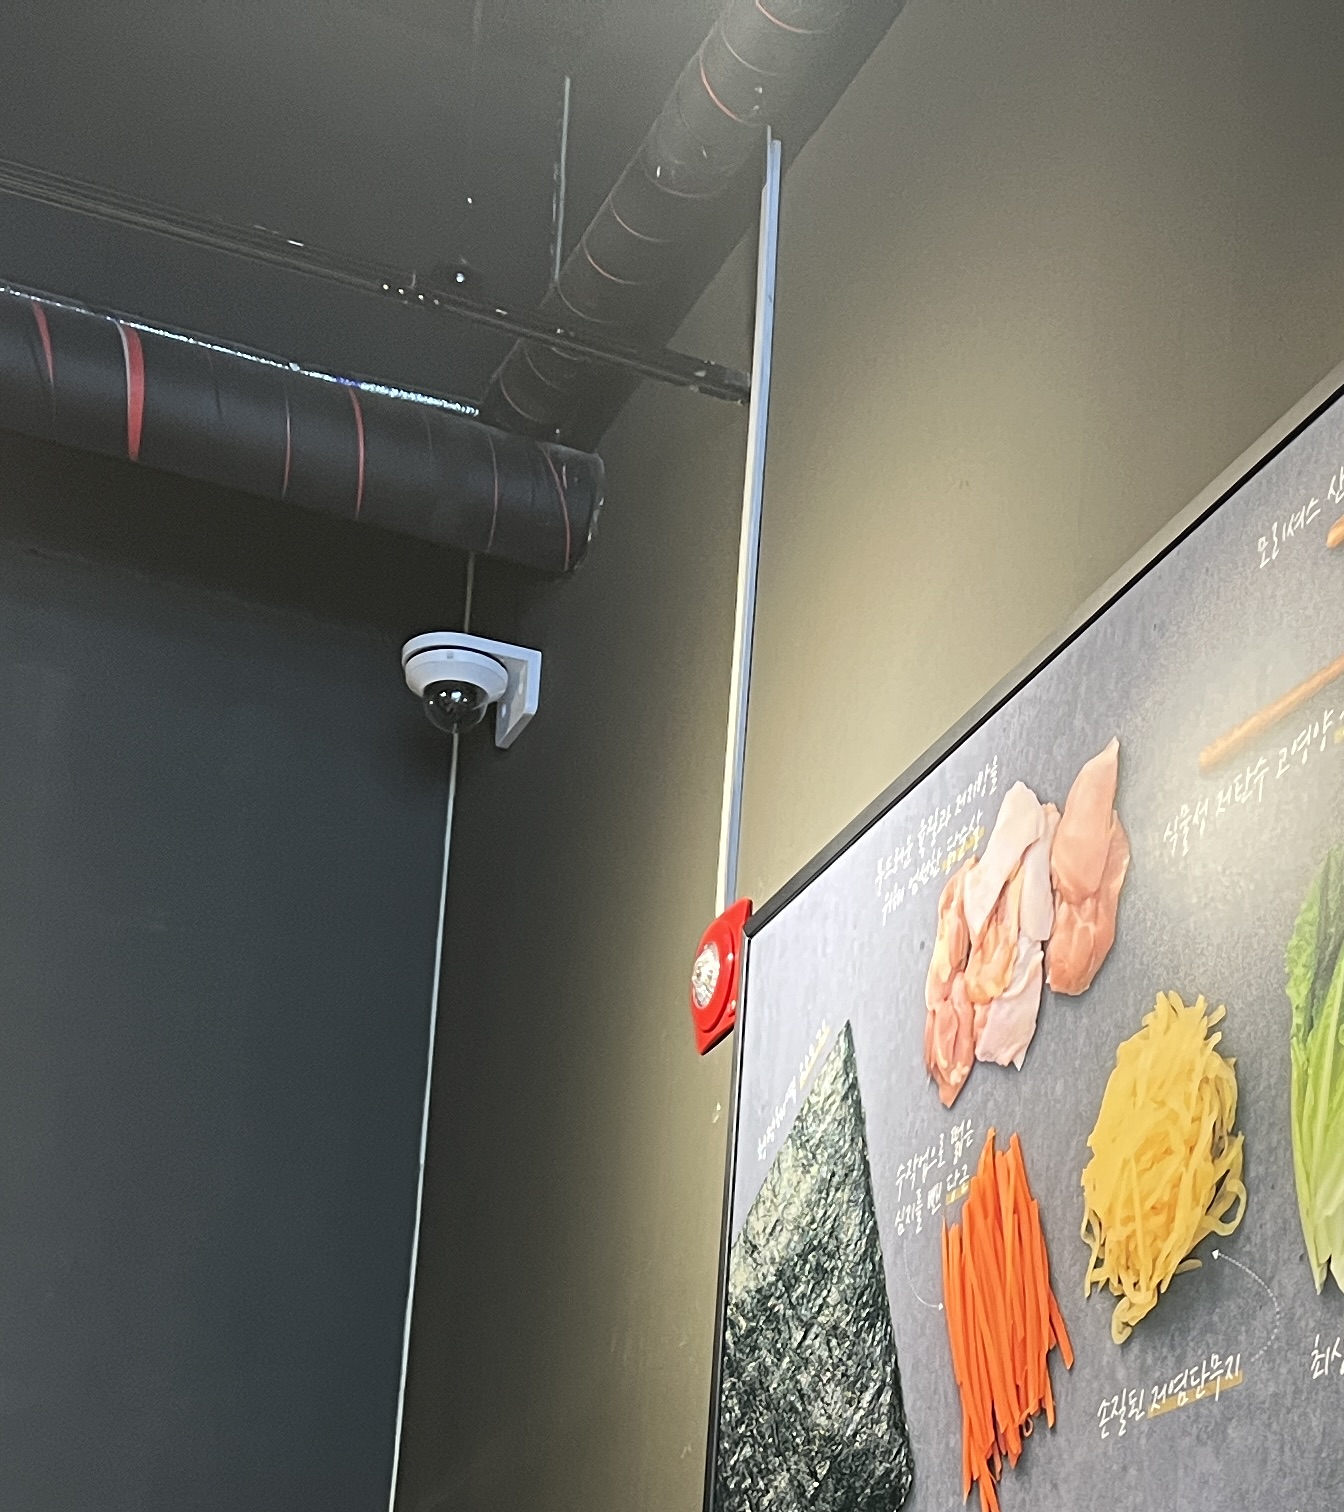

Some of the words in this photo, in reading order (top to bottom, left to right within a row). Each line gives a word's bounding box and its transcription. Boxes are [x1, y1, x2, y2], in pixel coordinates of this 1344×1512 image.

[946, 1163, 970, 1203] 당근
[1097, 1388, 1145, 1439] 손질된
[1150, 1353, 1242, 1413] 저염단무지
